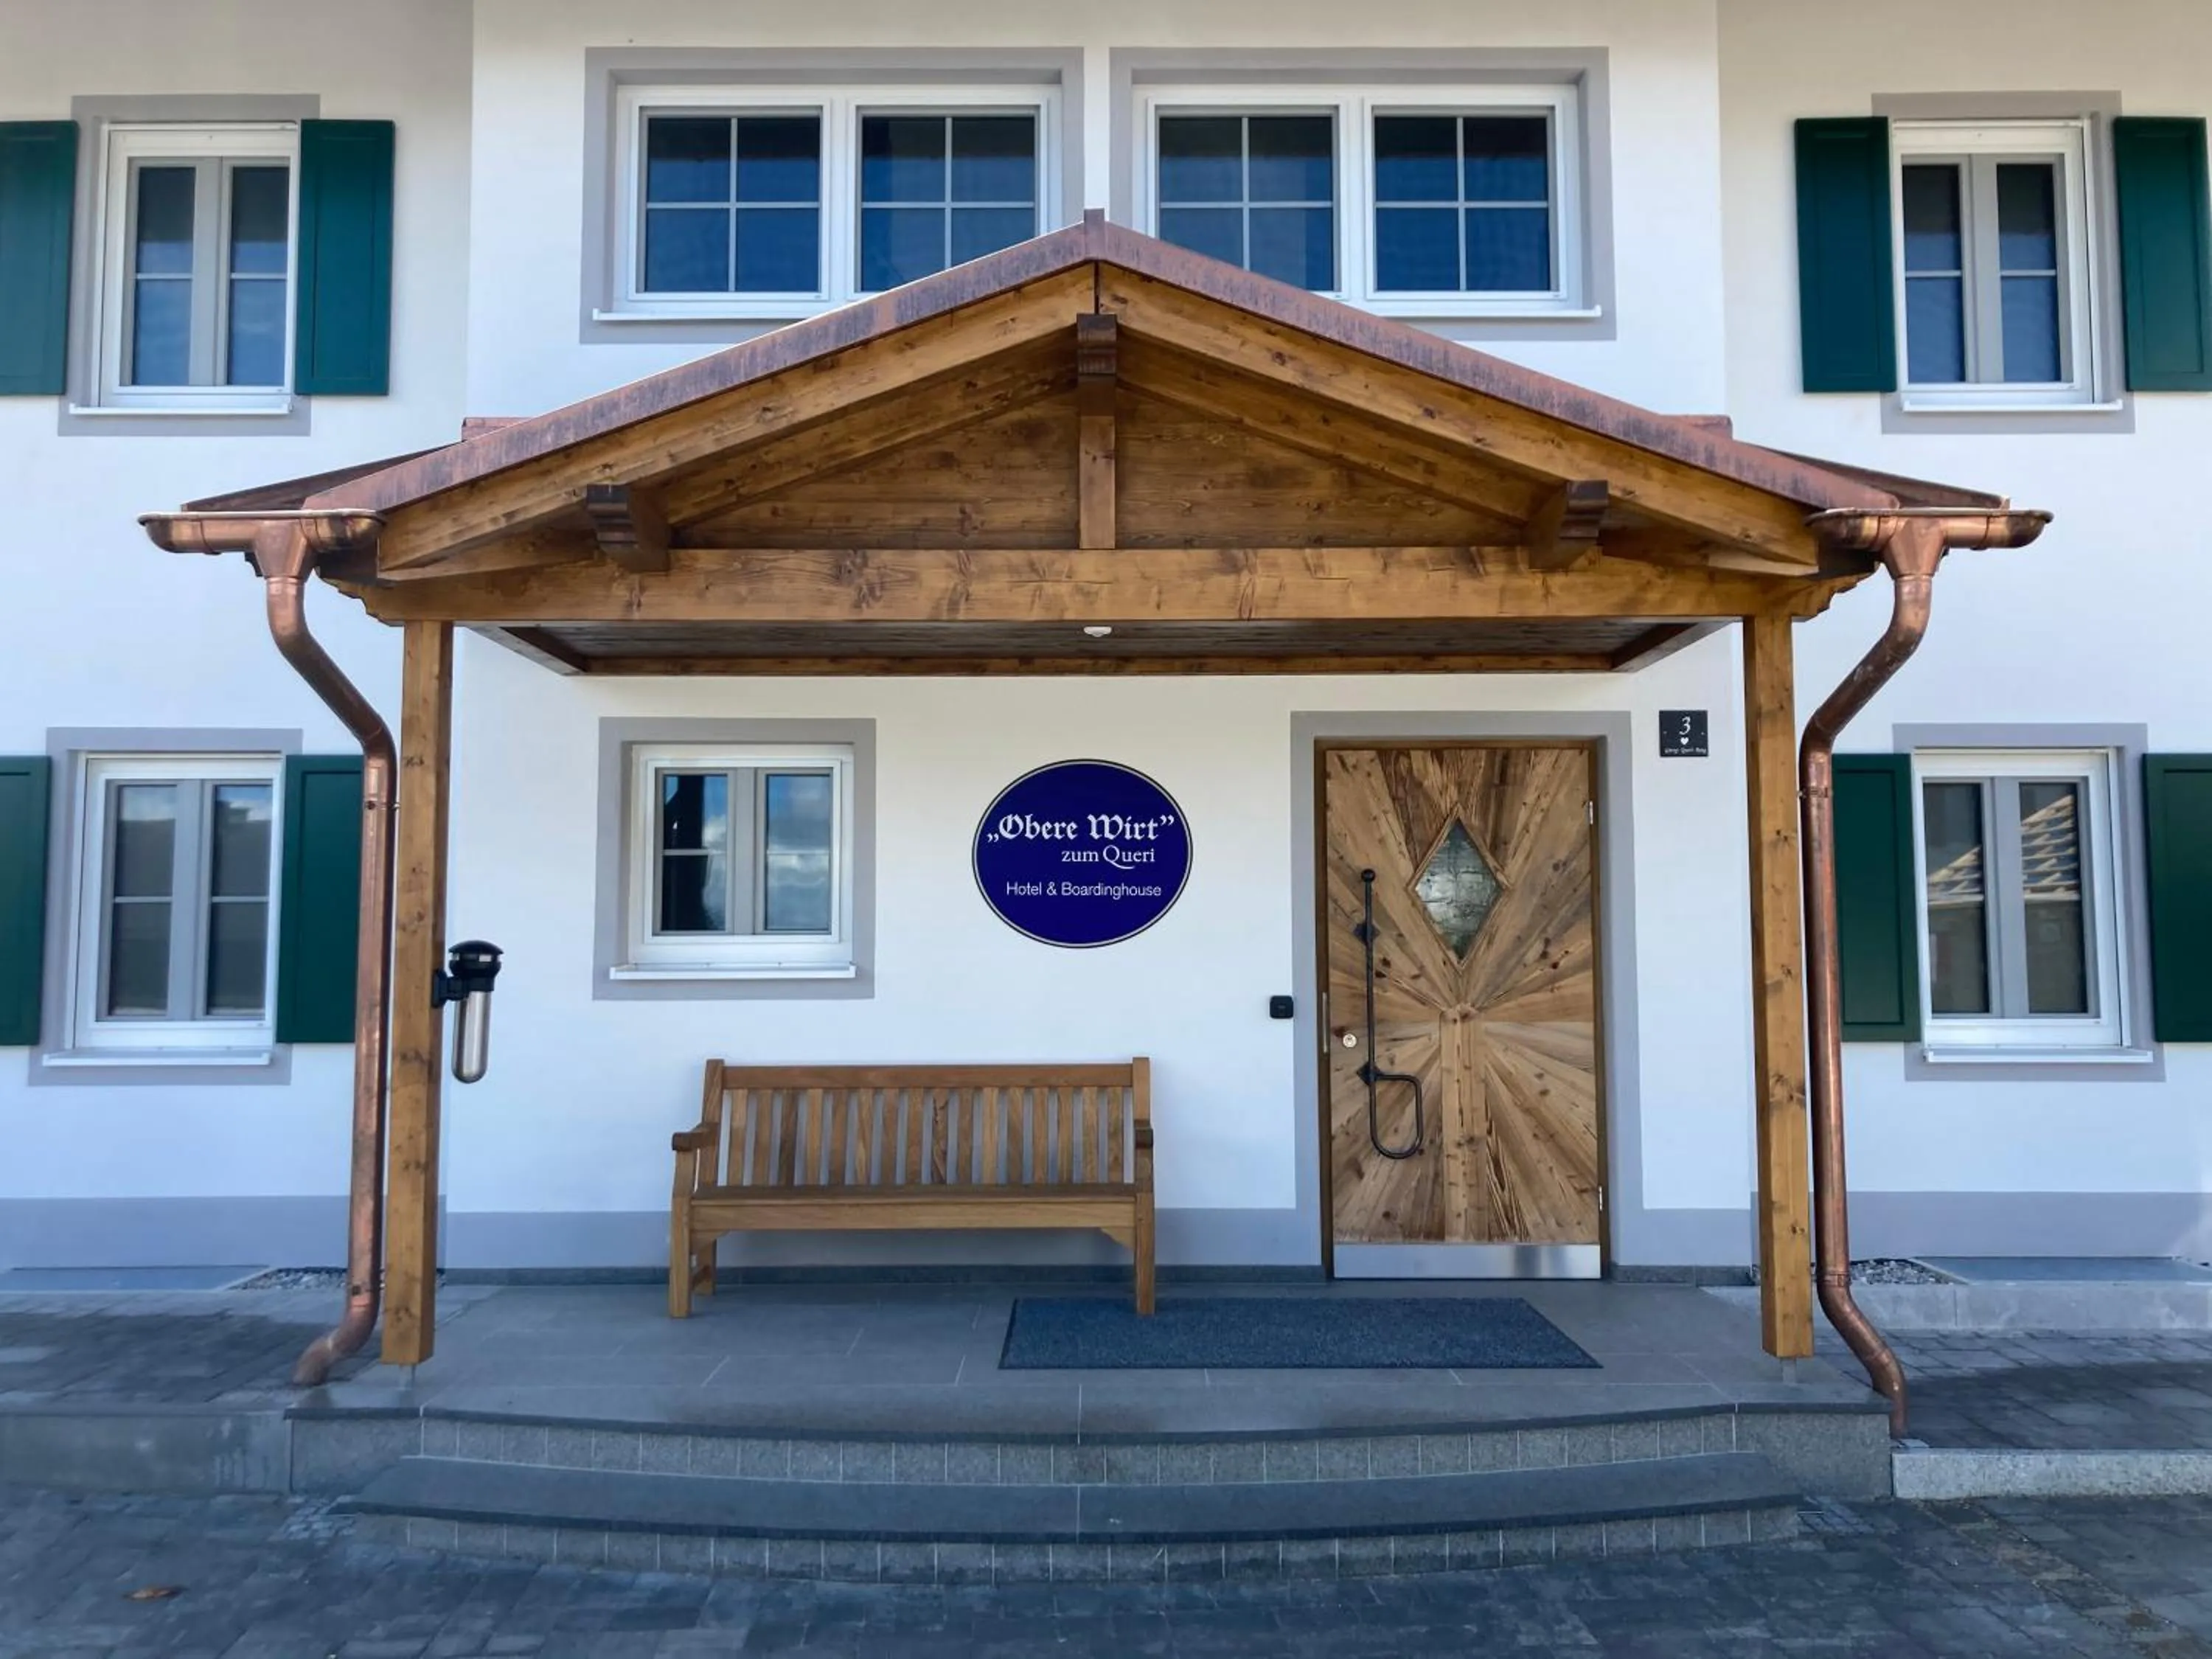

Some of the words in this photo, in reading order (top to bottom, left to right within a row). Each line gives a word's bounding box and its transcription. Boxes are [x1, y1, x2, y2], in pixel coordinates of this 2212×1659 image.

[1679, 716, 1691, 735] 3
[1062, 851, 1099, 862] zum
[1103, 844, 1155, 869] Queri
[1007, 882, 1042, 895] Hotel
[1046, 882, 1057, 896] &
[1062, 882, 1161, 900] Boardinghouse
